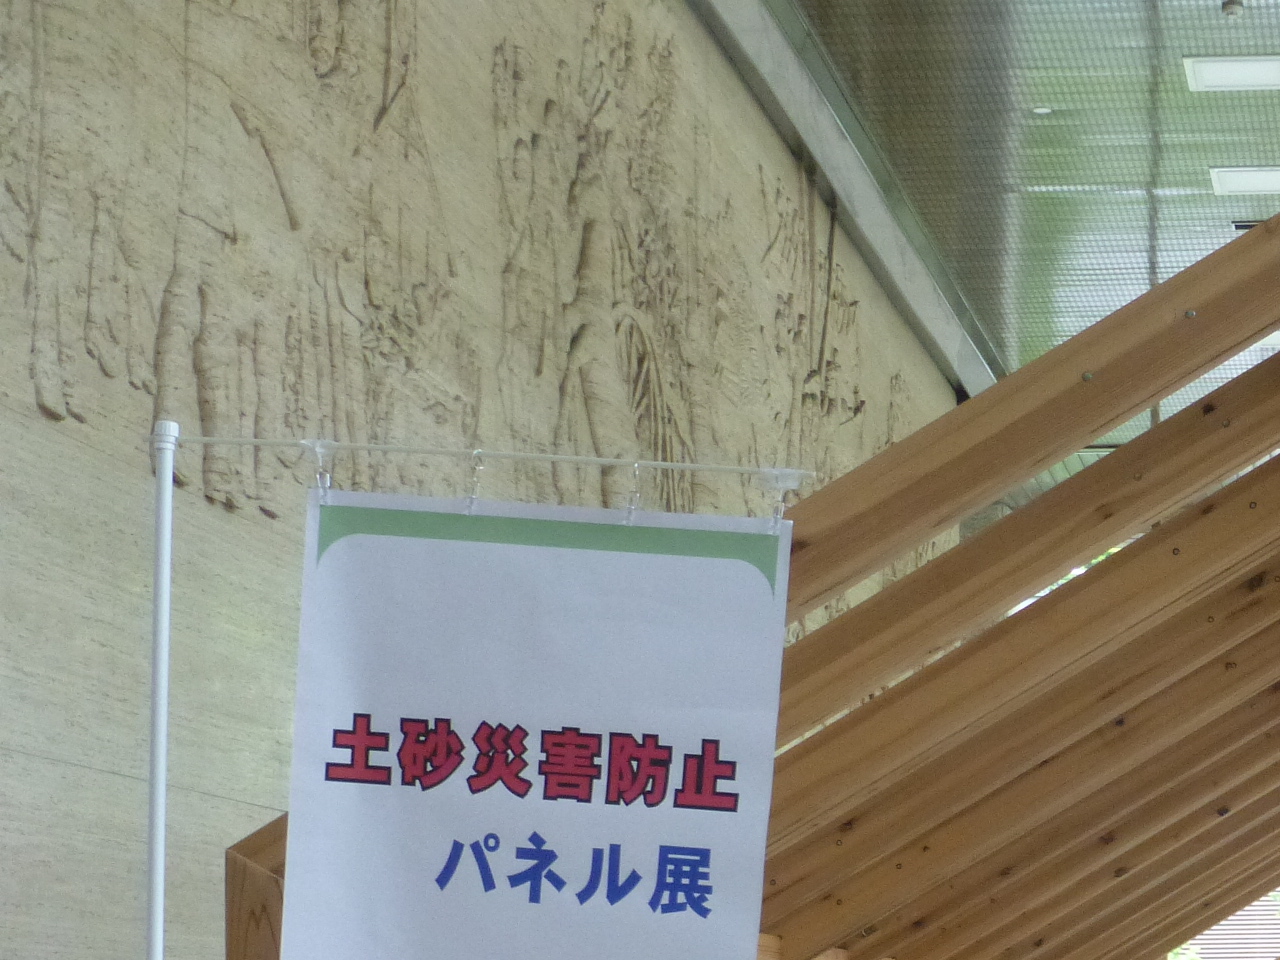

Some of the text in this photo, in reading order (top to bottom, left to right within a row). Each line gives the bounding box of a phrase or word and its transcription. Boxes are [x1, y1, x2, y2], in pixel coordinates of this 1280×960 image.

[325, 713, 739, 812] 土砂災害防止
[435, 831, 714, 918] パネル展
